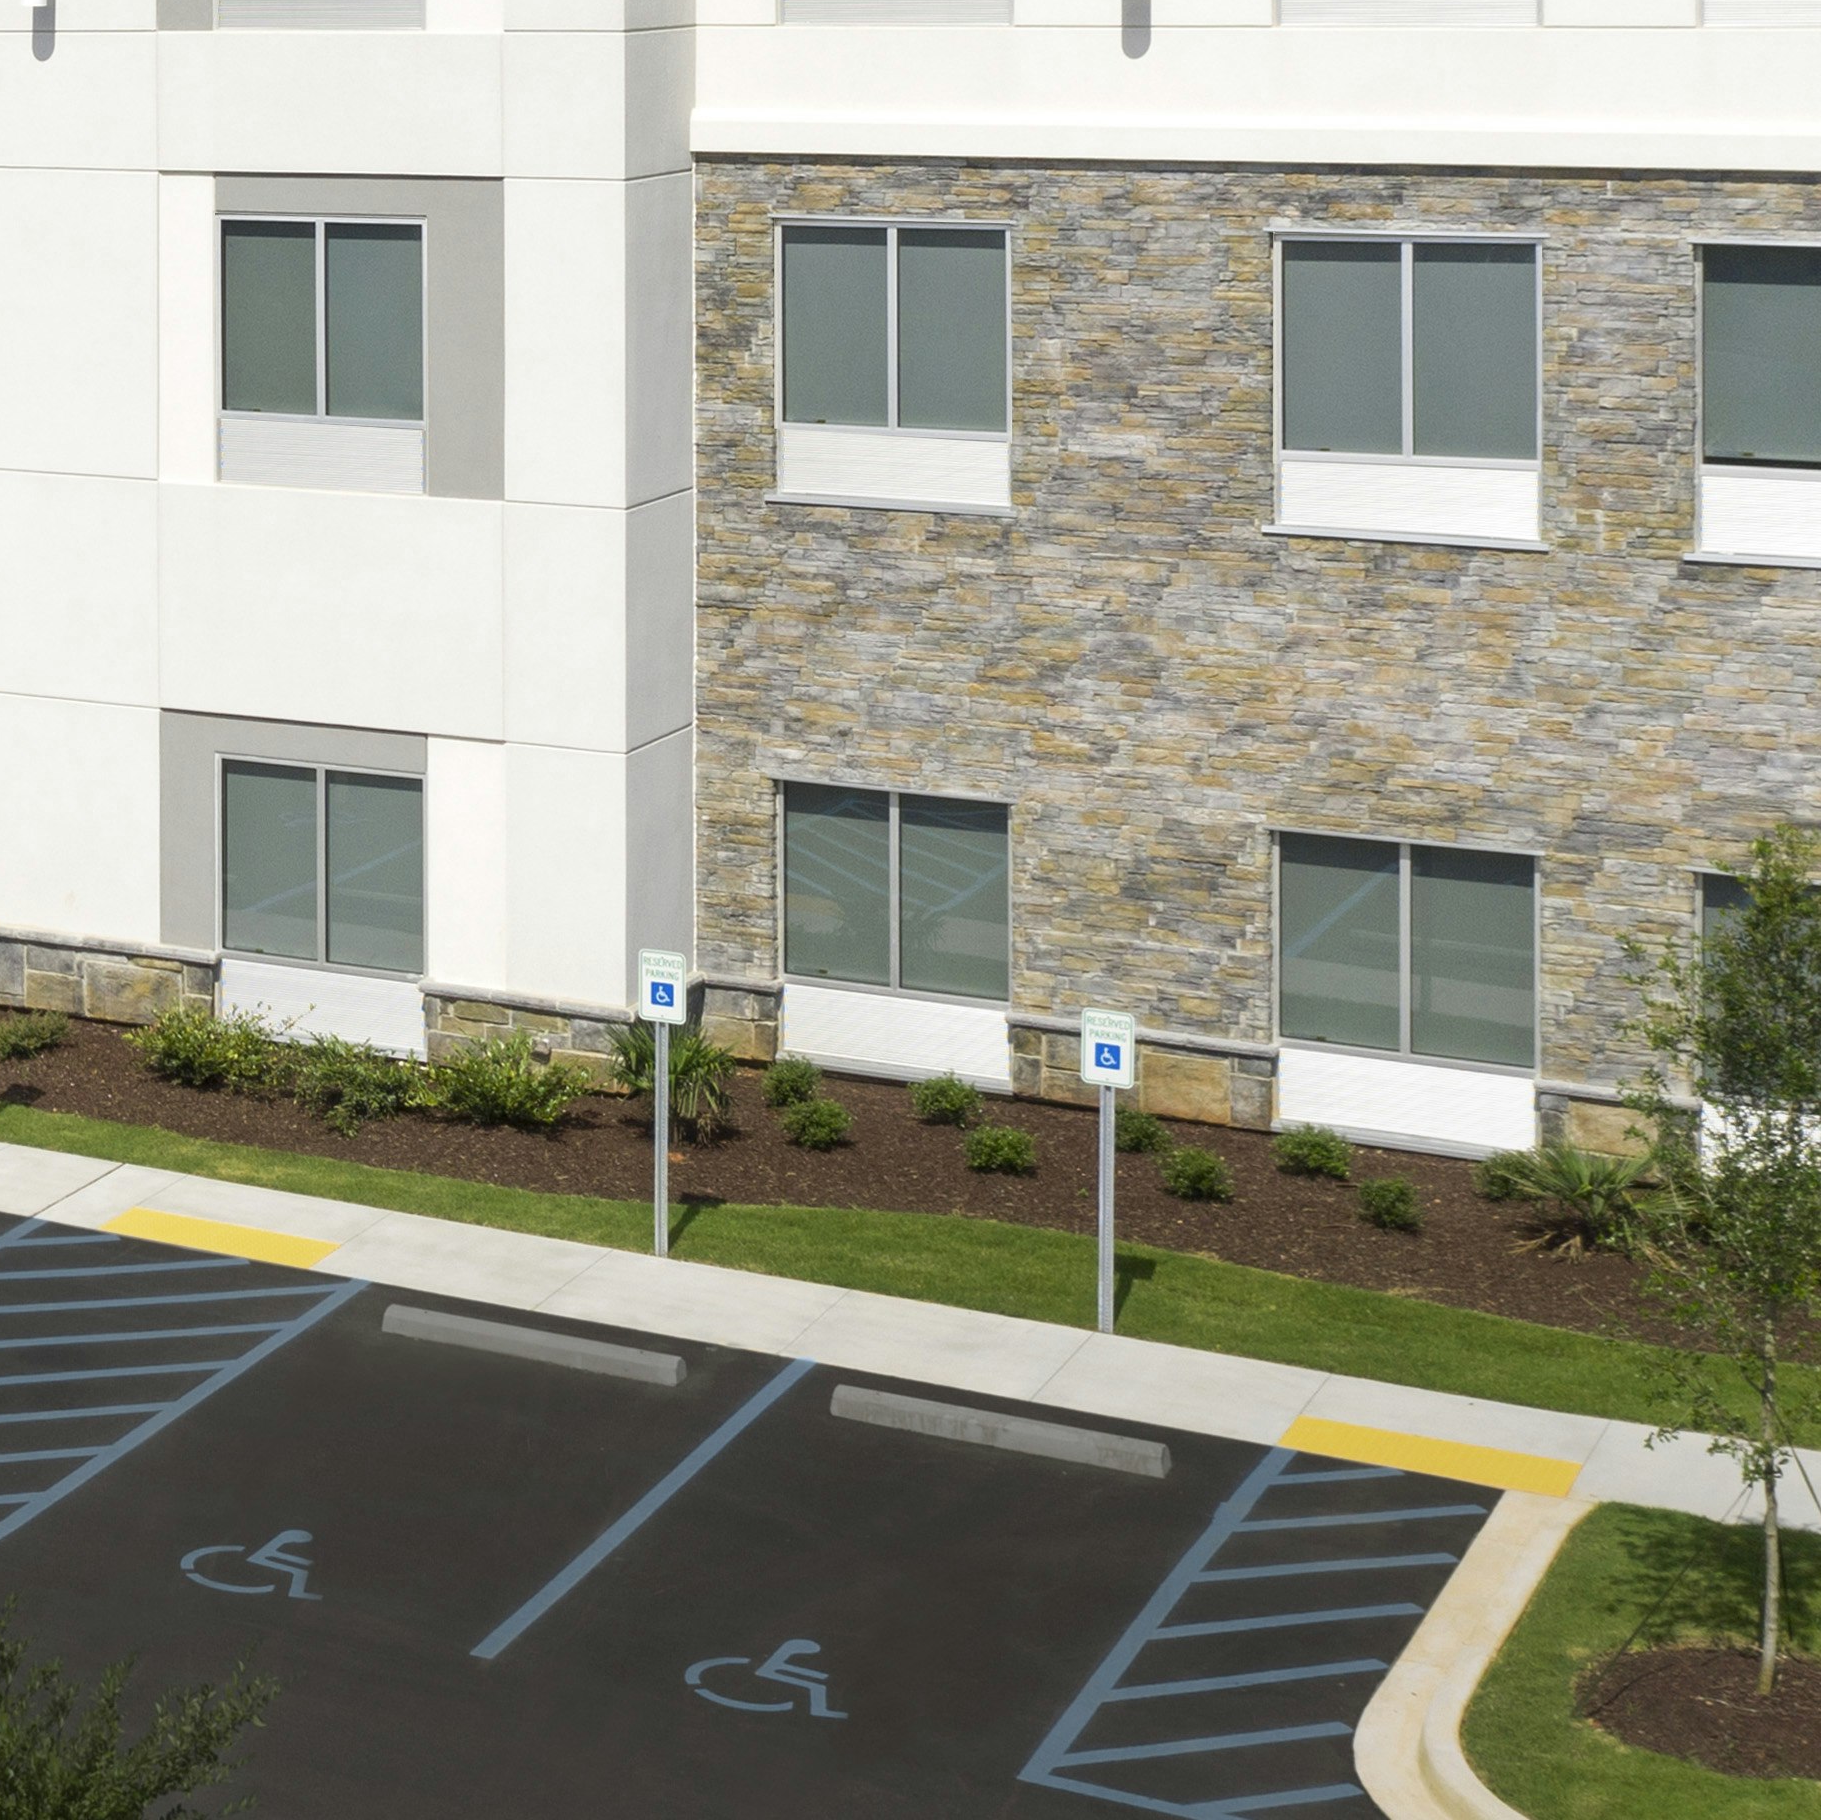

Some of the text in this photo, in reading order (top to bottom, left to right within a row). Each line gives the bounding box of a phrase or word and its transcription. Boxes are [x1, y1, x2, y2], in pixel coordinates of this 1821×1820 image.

[643, 956, 683, 969] RESERVED
[645, 968, 680, 981] PARKING
[1087, 1015, 1131, 1030] RESERVED
[1089, 1028, 1127, 1043] PARKING
